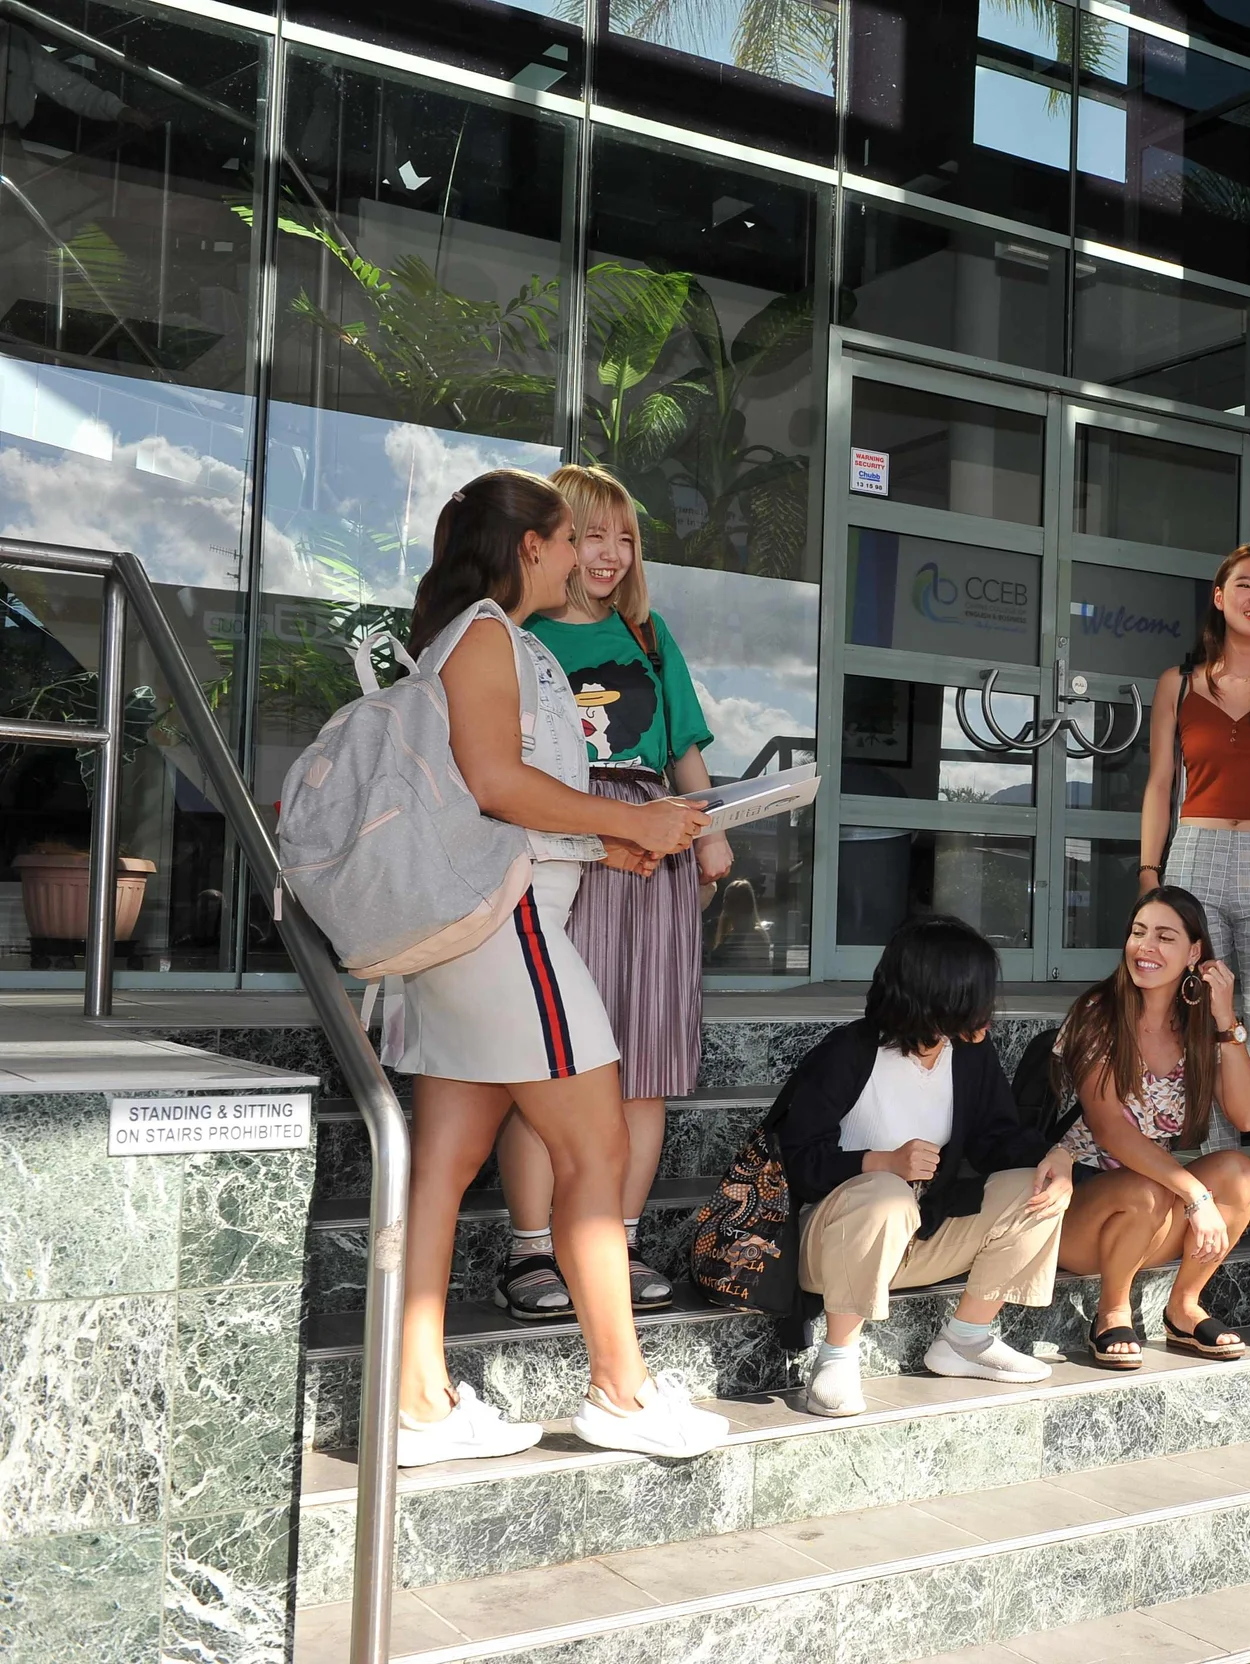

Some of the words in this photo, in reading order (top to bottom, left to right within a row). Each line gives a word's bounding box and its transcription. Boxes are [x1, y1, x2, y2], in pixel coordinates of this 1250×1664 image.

[854, 460, 885, 471] SECURITY
[855, 452, 884, 463] WARNING
[858, 470, 881, 480] Chubb
[965, 576, 1028, 606] CCEB
[1080, 597, 1182, 639] Welcome
[128, 1104, 212, 1122] STANDING
[217, 1104, 229, 1119] &
[232, 1103, 294, 1119] SITTING
[115, 1128, 140, 1144] ON
[145, 1126, 203, 1144] STAIRS
[208, 1123, 303, 1141] PROHIBITED
